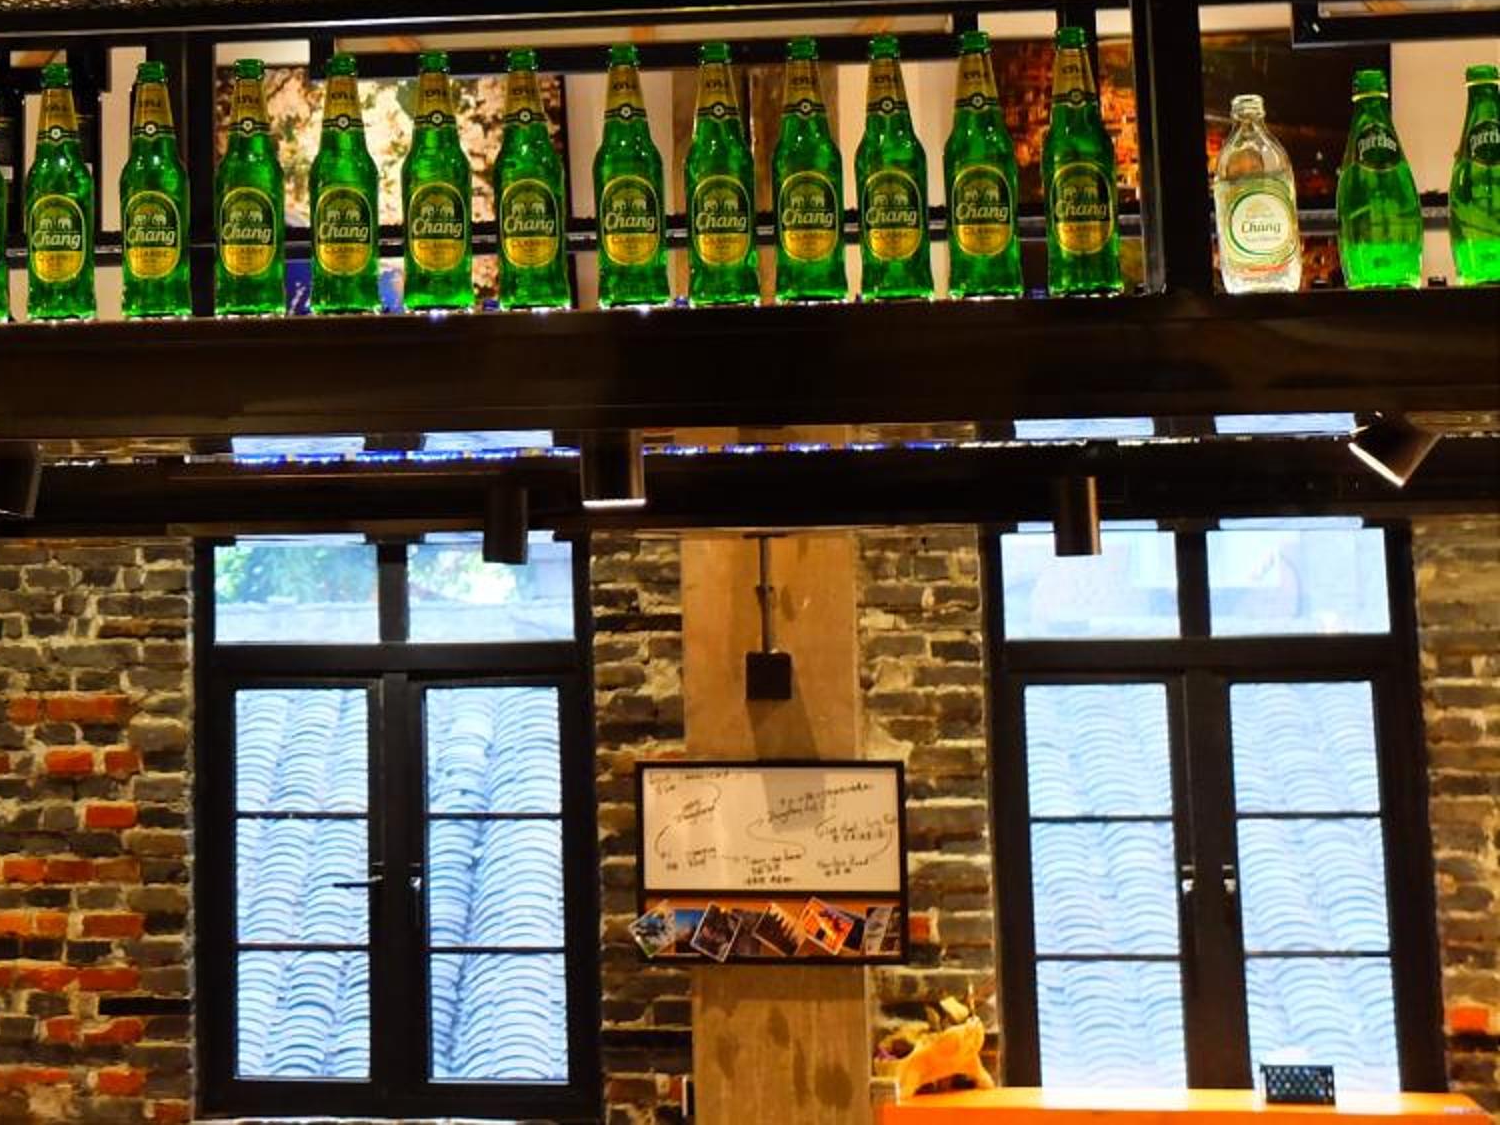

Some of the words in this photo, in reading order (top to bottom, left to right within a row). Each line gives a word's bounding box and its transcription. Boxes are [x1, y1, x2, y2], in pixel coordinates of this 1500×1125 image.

[866, 208, 916, 226] Chang
[956, 203, 1008, 222] Chang
[1055, 200, 1107, 219] Chang
[412, 218, 462, 237] Chang
[504, 215, 553, 233] Chang
[605, 212, 655, 231] Chang
[696, 213, 746, 232] Chang
[782, 210, 833, 229] Chang
[1241, 220, 1281, 234] Chang
[33, 231, 81, 249] Chang
[127, 227, 175, 246] Chang
[222, 223, 271, 242] Chang
[319, 223, 368, 241] Chang
